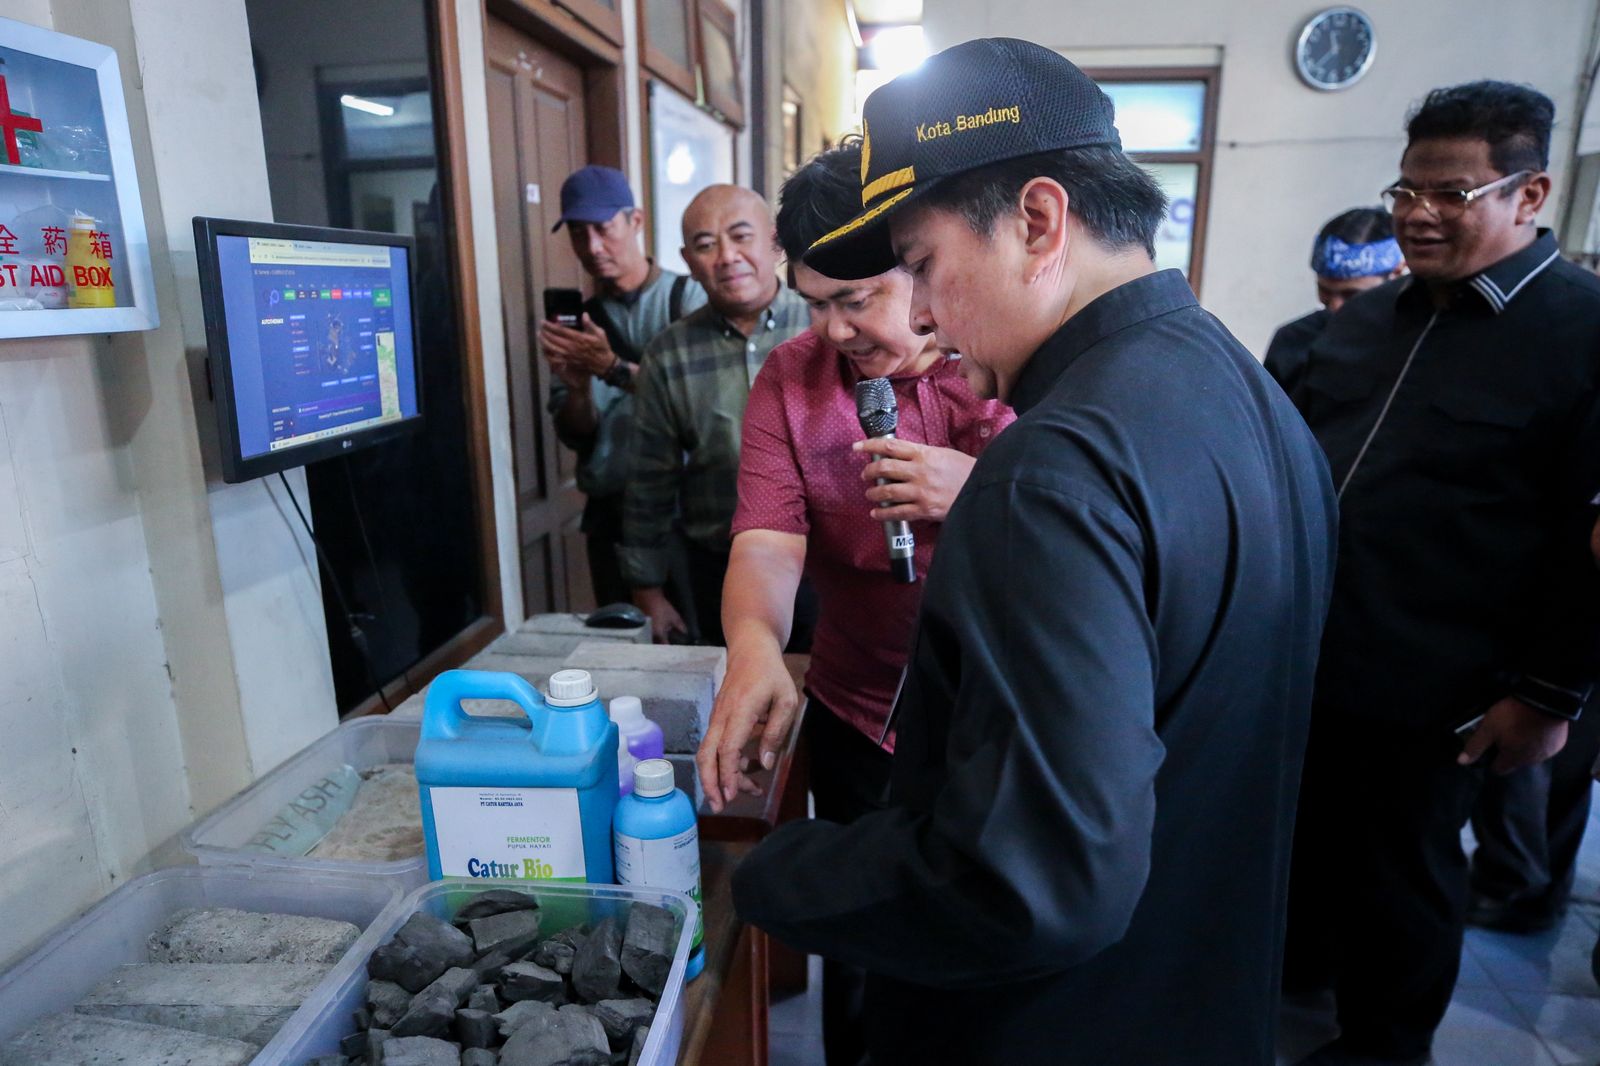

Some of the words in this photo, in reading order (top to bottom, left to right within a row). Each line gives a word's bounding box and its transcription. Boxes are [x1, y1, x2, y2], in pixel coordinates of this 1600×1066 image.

[916, 121, 951, 143] Kota
[957, 106, 1019, 131] Bandung
[31, 264, 66, 287] AID
[73, 265, 114, 286] BOX
[246, 815, 298, 851] FLY
[288, 777, 343, 821] ASH
[467, 857, 520, 879] Catur
[522, 858, 553, 880] Bio
